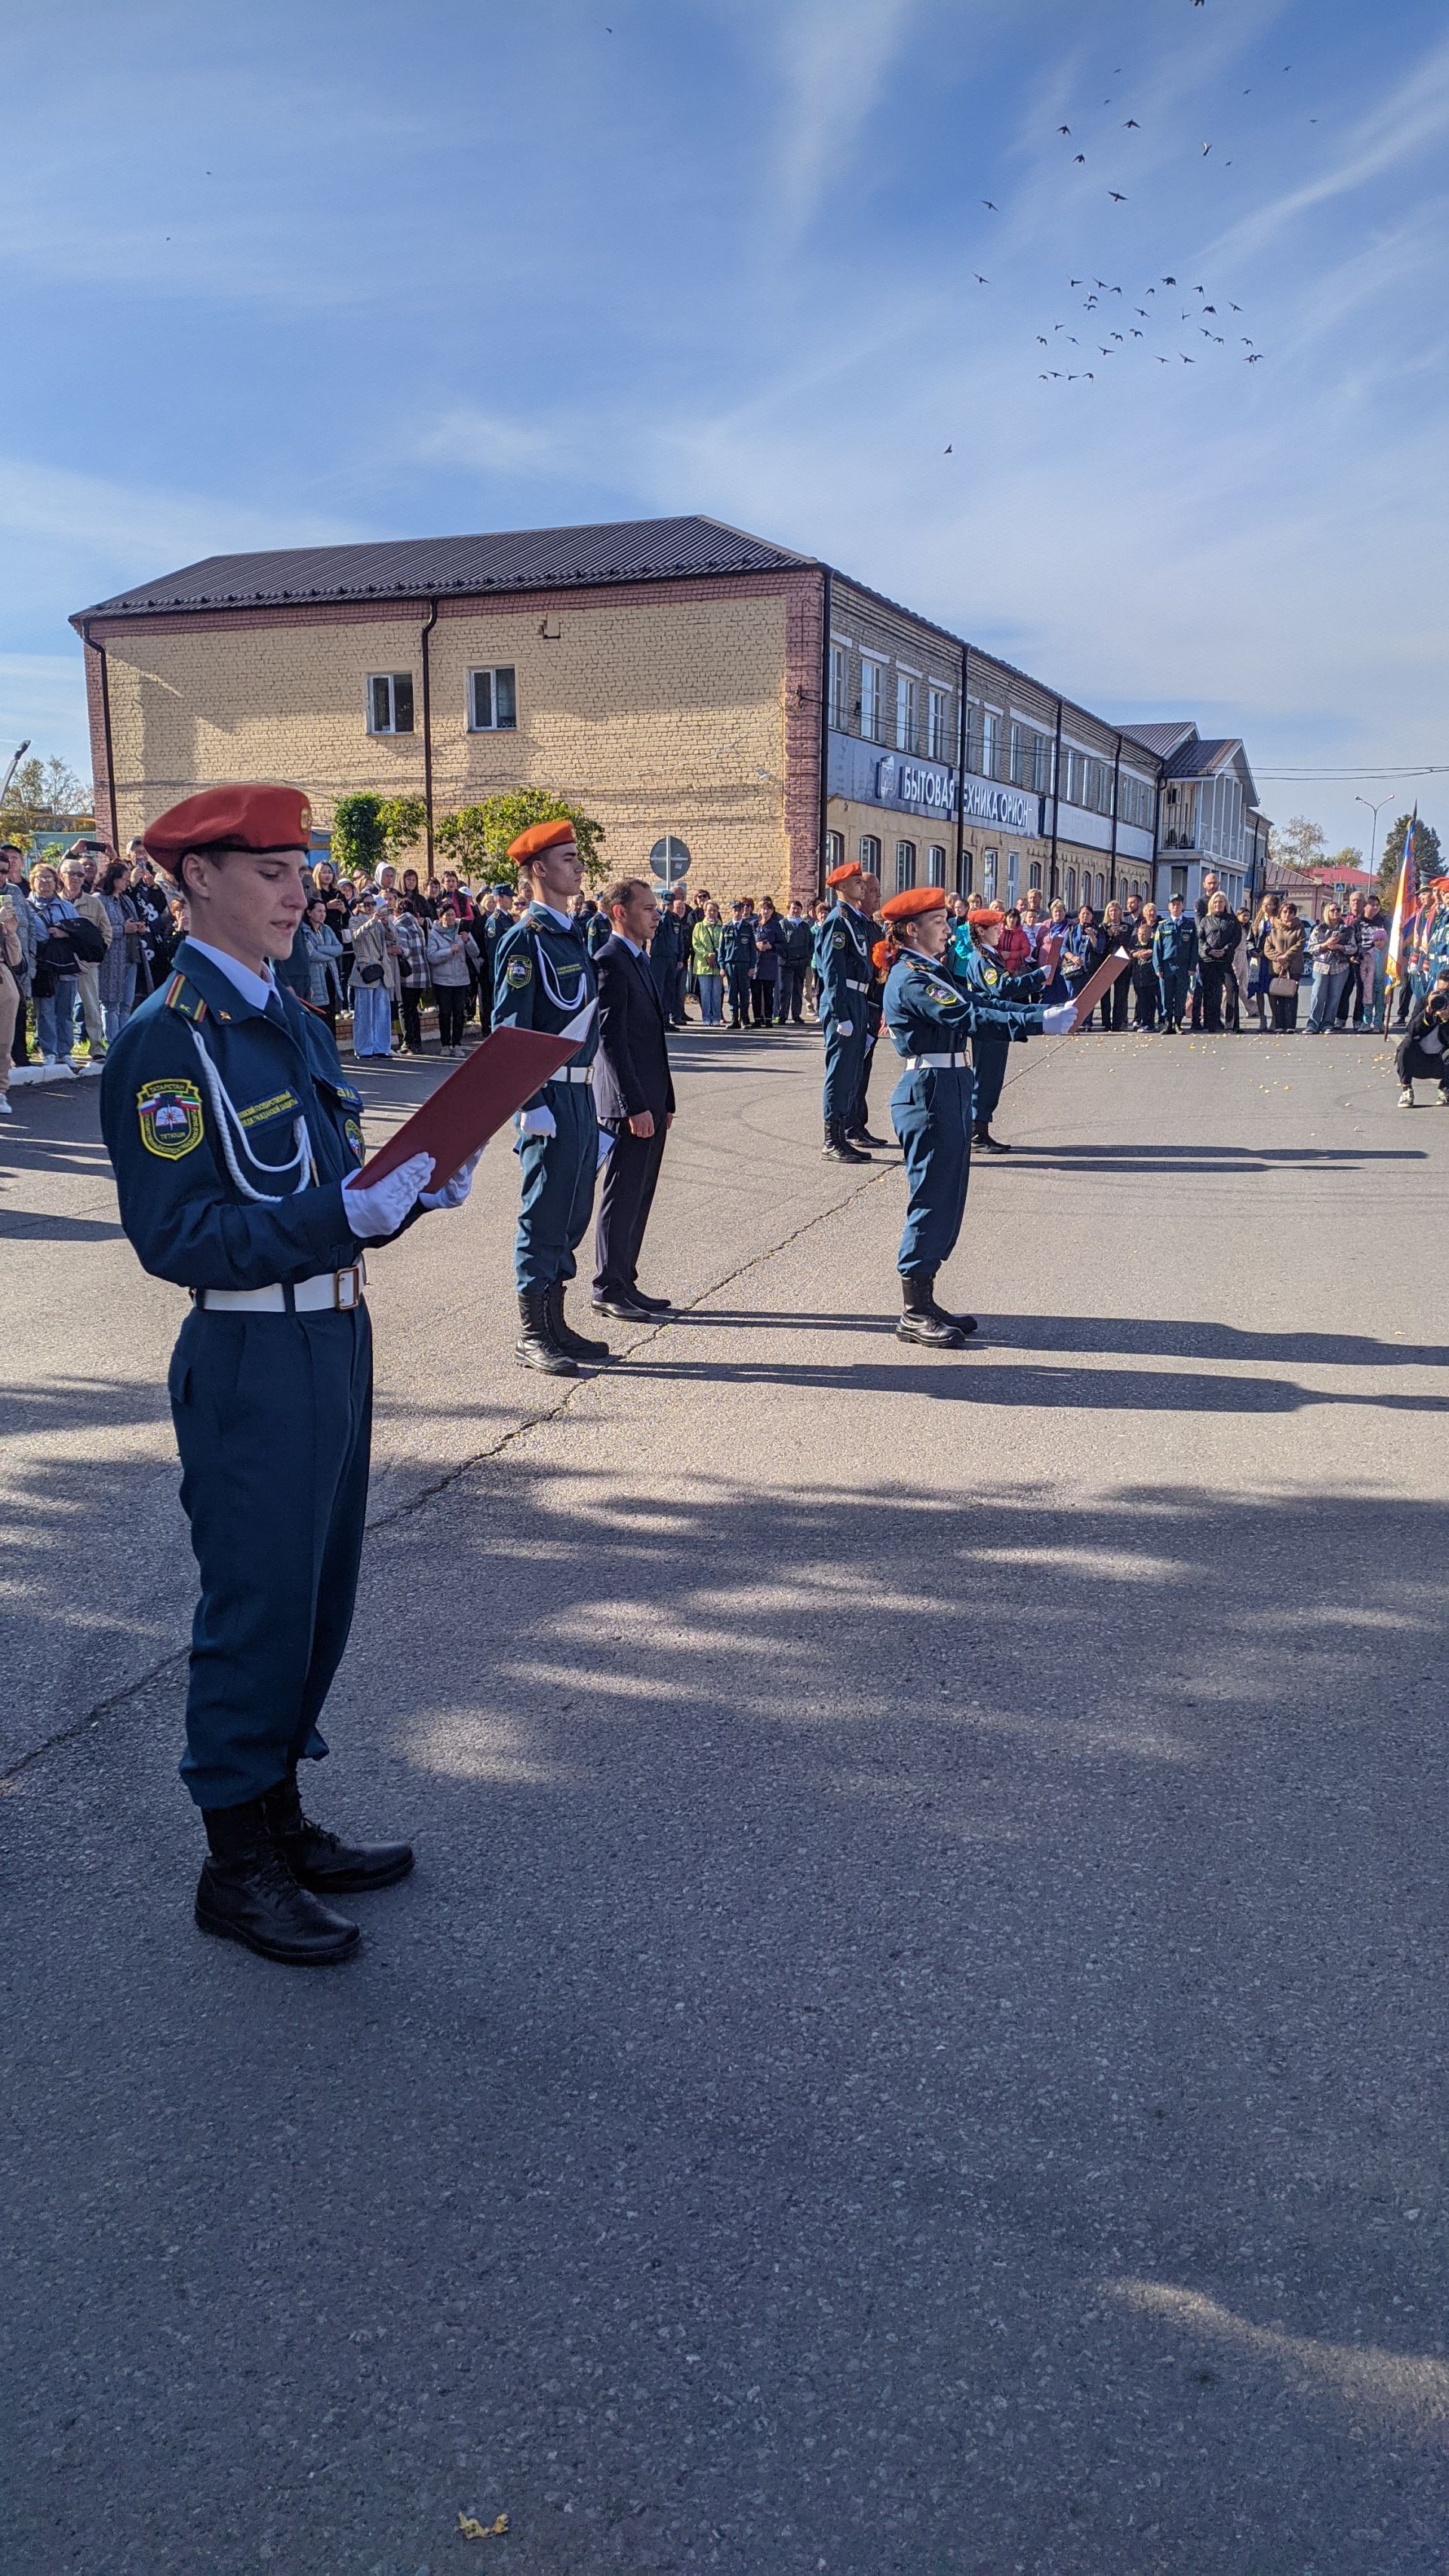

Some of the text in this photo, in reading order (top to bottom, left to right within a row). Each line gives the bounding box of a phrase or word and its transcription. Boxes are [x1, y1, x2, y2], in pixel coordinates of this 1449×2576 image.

[904, 767, 1028, 826] БЫТОВАЯ ЕХНИКА ОРИОН
[149, 1084, 185, 1094] ТАТАРСТАН
